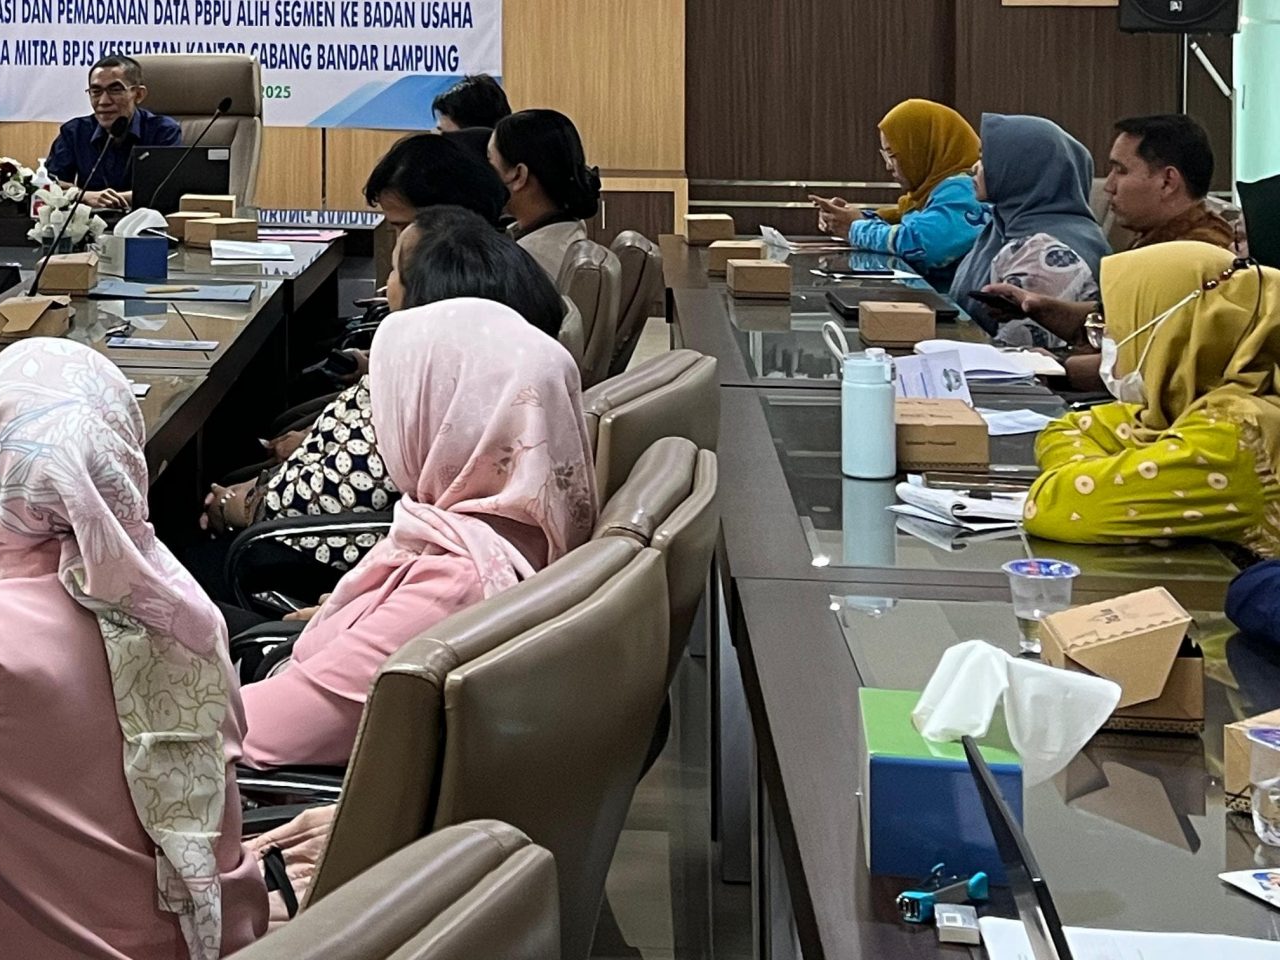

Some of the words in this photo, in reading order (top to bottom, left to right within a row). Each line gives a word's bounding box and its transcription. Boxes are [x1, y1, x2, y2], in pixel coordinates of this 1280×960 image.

[154, 0, 190, 25] DATA
[195, 0, 232, 26] PBPU
[236, 0, 270, 26] ALIH
[275, 0, 335, 27] SEGMEN
[341, 1, 358, 27] KE
[364, 1, 415, 28] BADAN
[421, 2, 473, 28] USAHA
[15, 40, 58, 66] MITRA
[63, 40, 94, 66] BPJS
[317, 43, 379, 70] BANDAR
[384, 44, 459, 72] LAMPUNG
